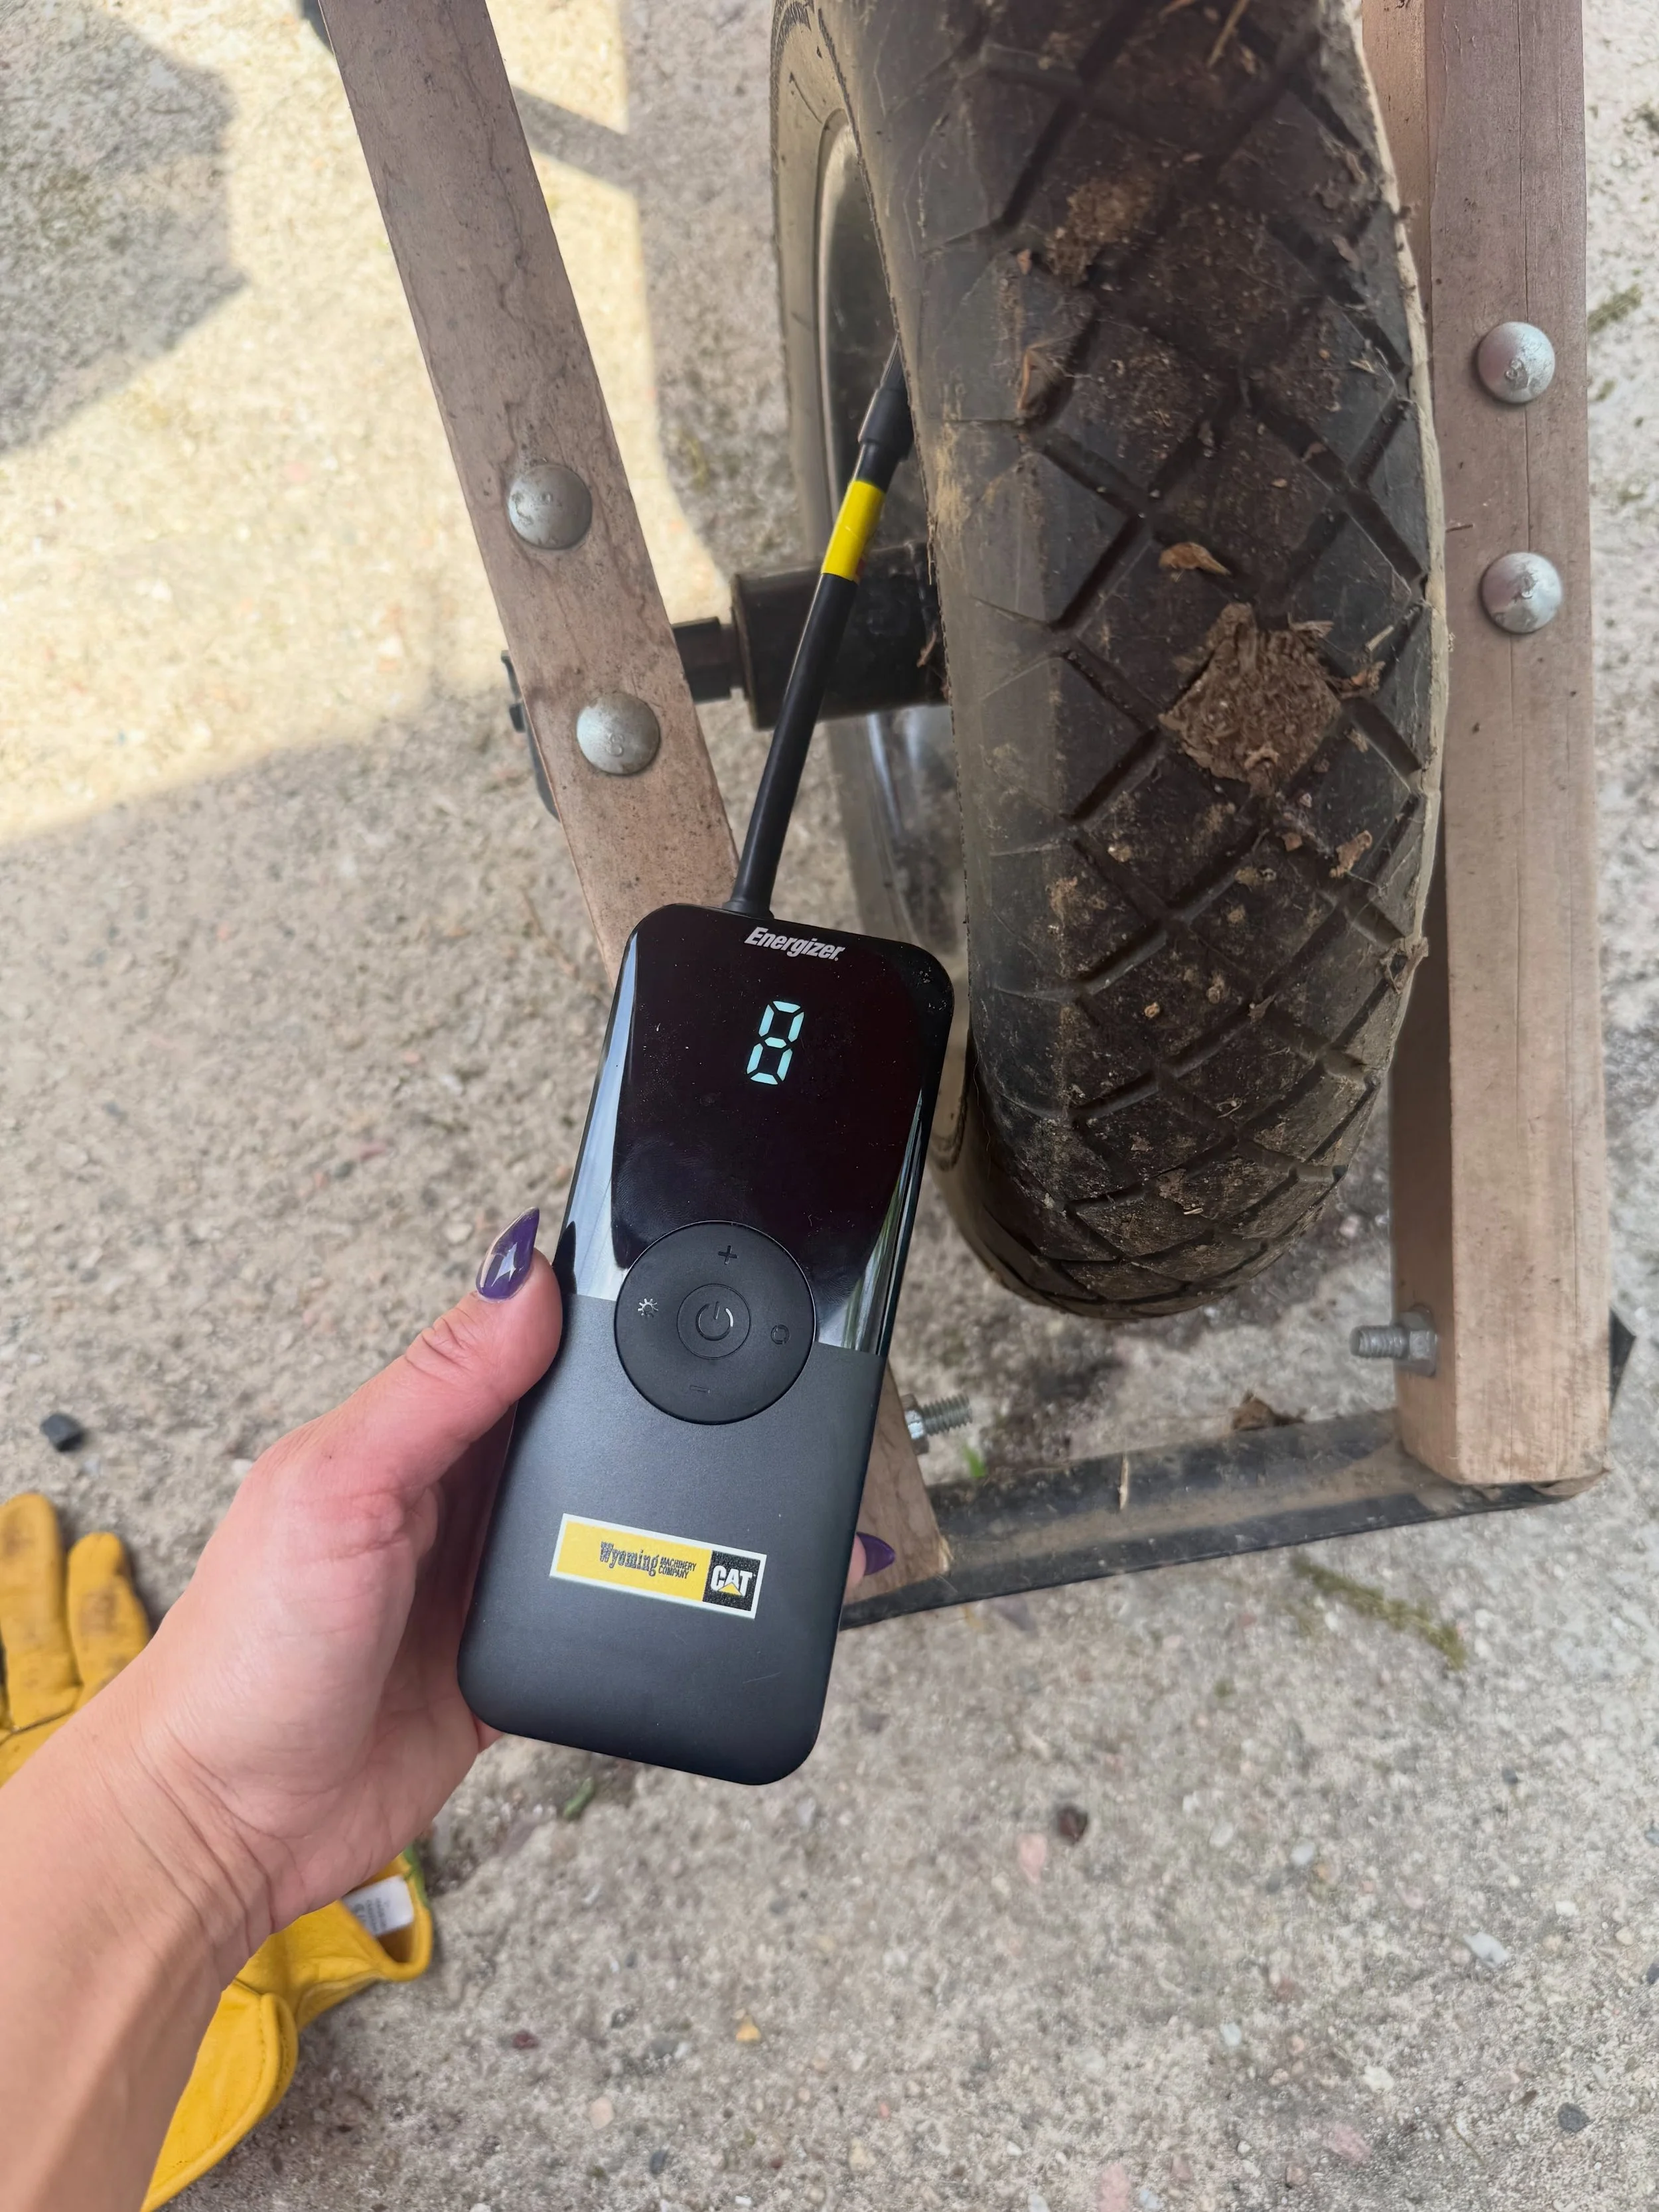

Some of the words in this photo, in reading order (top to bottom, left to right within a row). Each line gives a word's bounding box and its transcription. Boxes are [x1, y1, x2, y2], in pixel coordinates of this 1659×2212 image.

[747, 1001, 804, 1085] 8
[600, 1541, 659, 1576] Wyoming
[660, 1557, 697, 1572] MACHINERY
[658, 1565, 689, 1579] COMPANY
[710, 1565, 753, 1596] CAT
